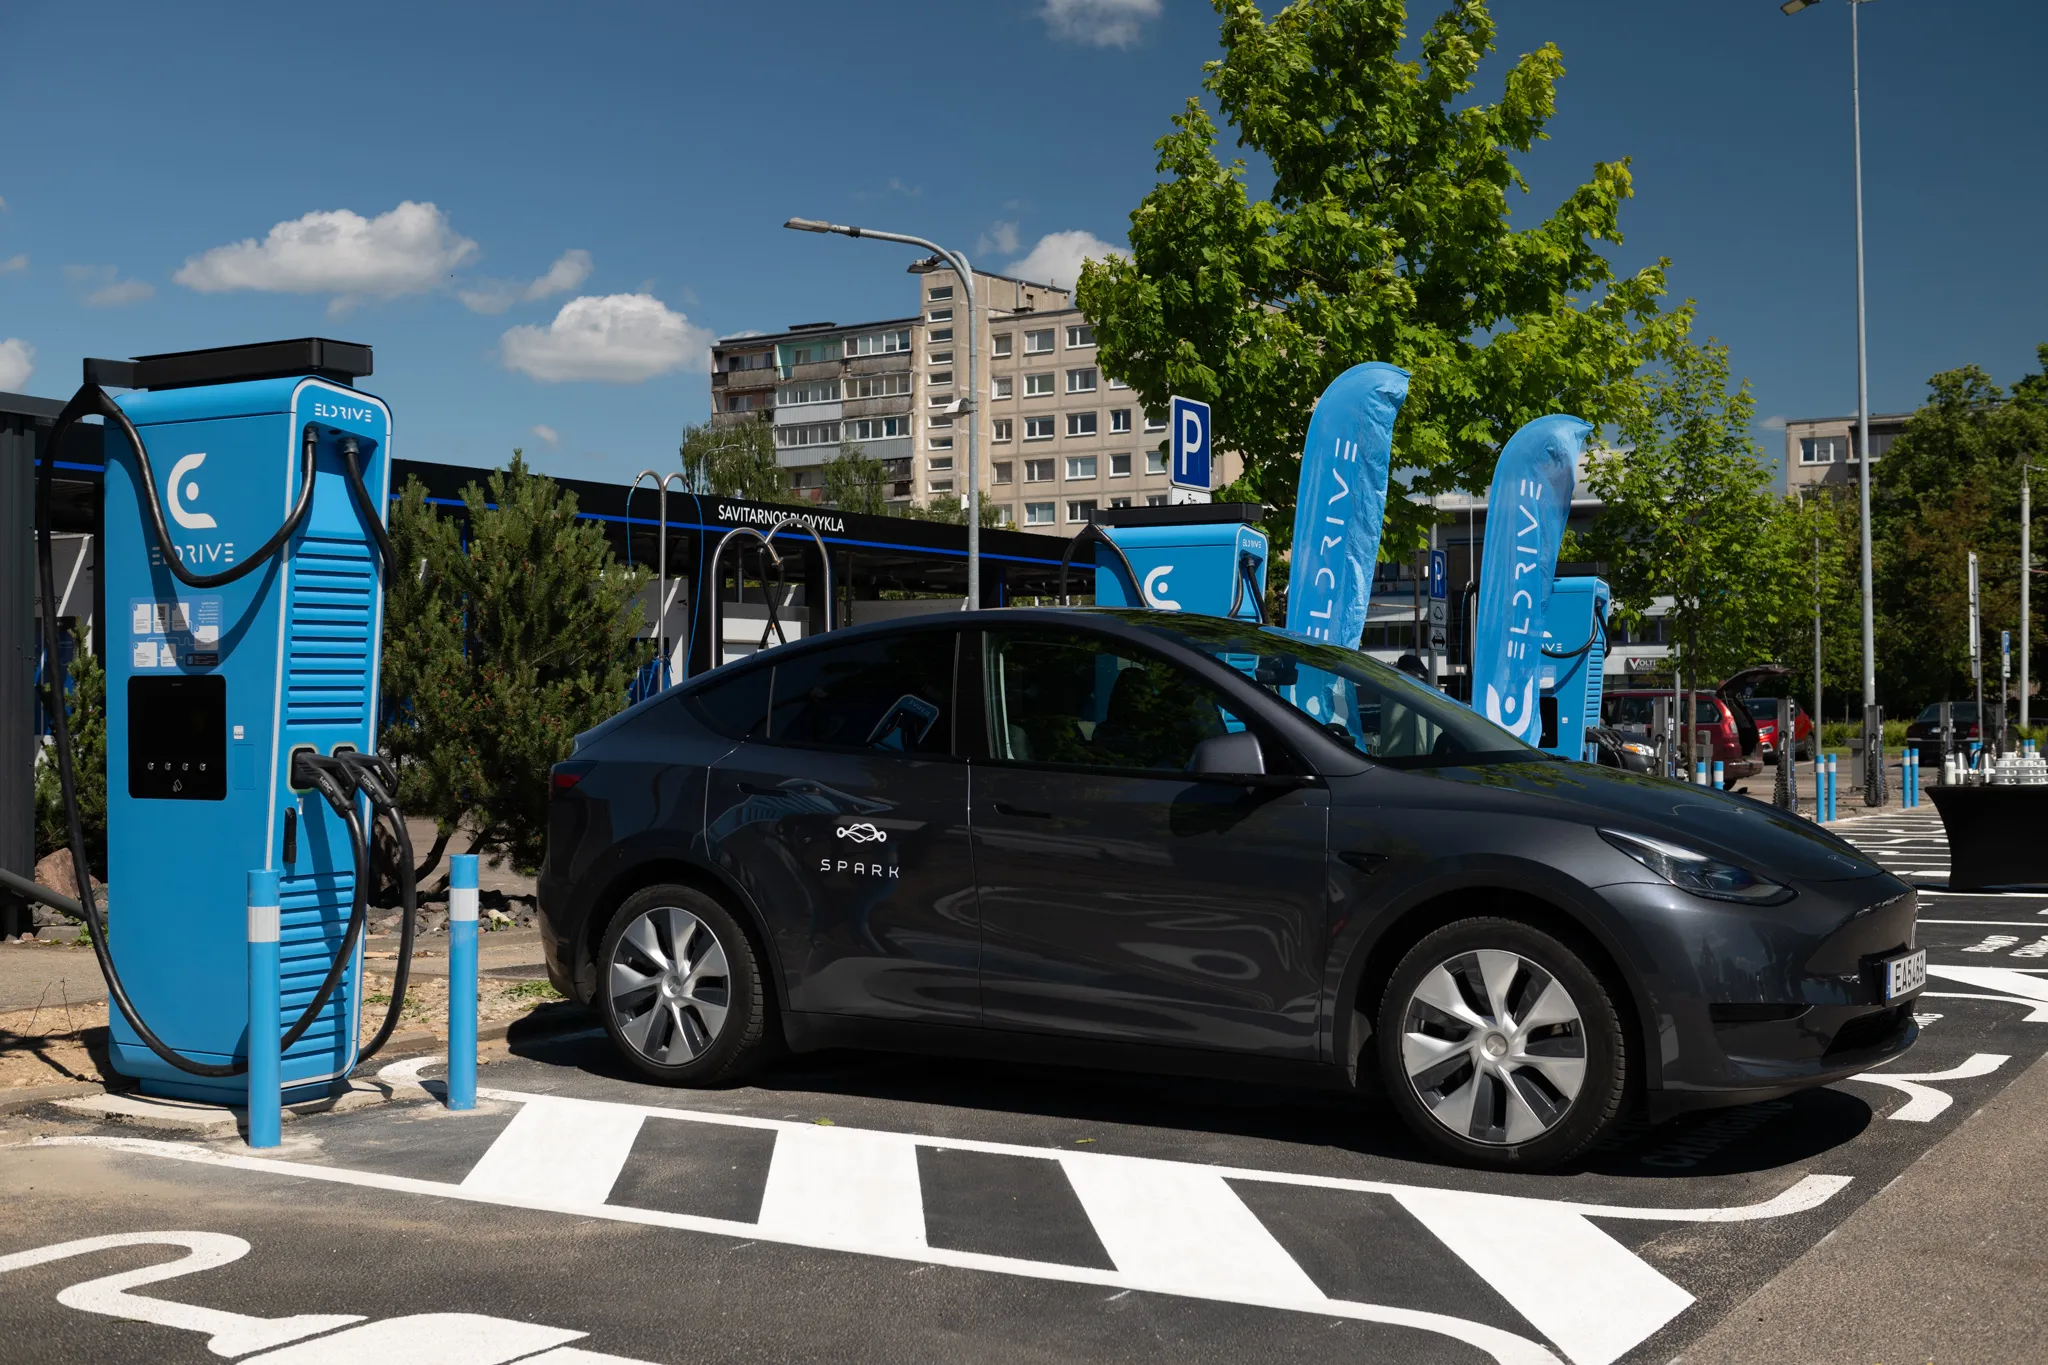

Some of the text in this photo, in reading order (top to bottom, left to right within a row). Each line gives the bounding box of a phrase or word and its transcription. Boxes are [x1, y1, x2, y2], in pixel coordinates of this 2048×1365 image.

[314, 403, 372, 423] ELDRIVE
[1182, 409, 1203, 476] P
[718, 504, 788, 526] SAVITARNOS
[1434, 556, 1444, 594] P
[1507, 479, 1543, 661] ELDRIVE
[319, 776, 334, 794] HPC
[360, 774, 375, 792] HPC
[820, 859, 900, 878] SPARK
[1895, 954, 1924, 993] EA5469
